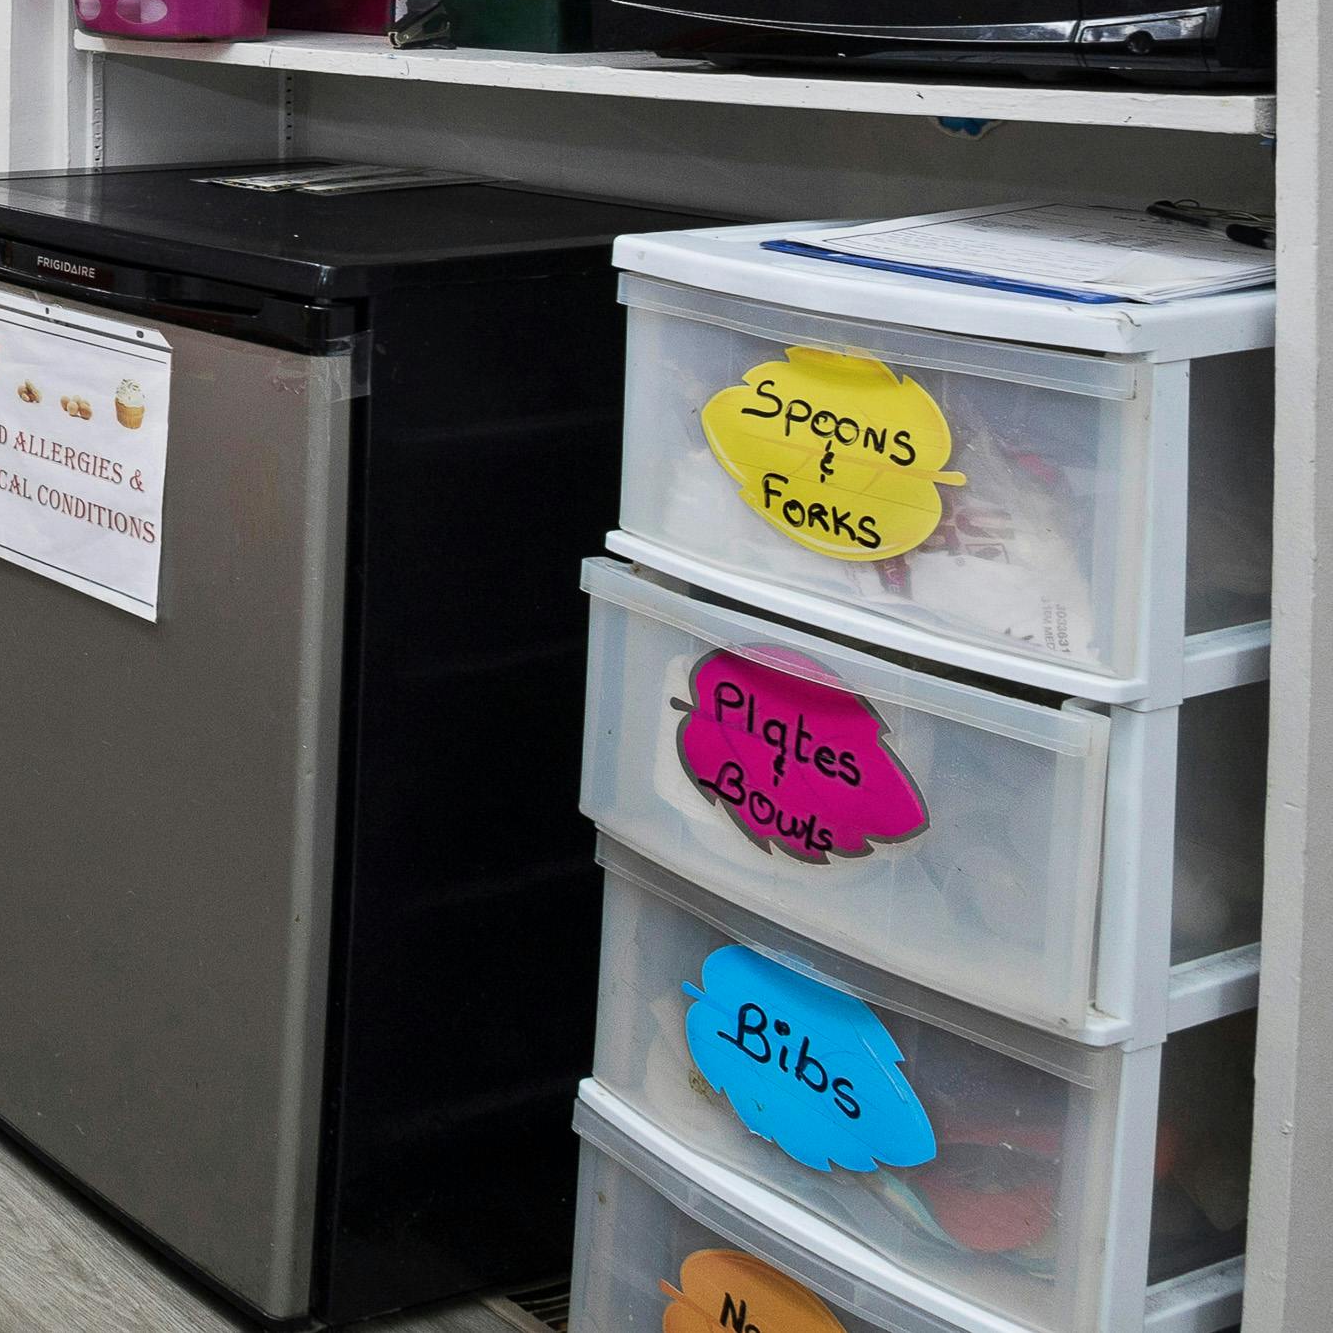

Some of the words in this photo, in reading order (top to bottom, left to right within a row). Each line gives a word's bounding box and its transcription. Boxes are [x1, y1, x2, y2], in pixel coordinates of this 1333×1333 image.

[36, 255, 96, 279] FRIGIDAIRE
[13, 430, 124, 485] ALLERGIES
[129, 468, 145, 492] &
[37, 484, 156, 544] CONDITIONS
[761, 472, 883, 550] FORKS
[713, 680, 864, 787] Plates
[697, 760, 835, 854] Bowls
[717, 1002, 862, 1121] Bibs
